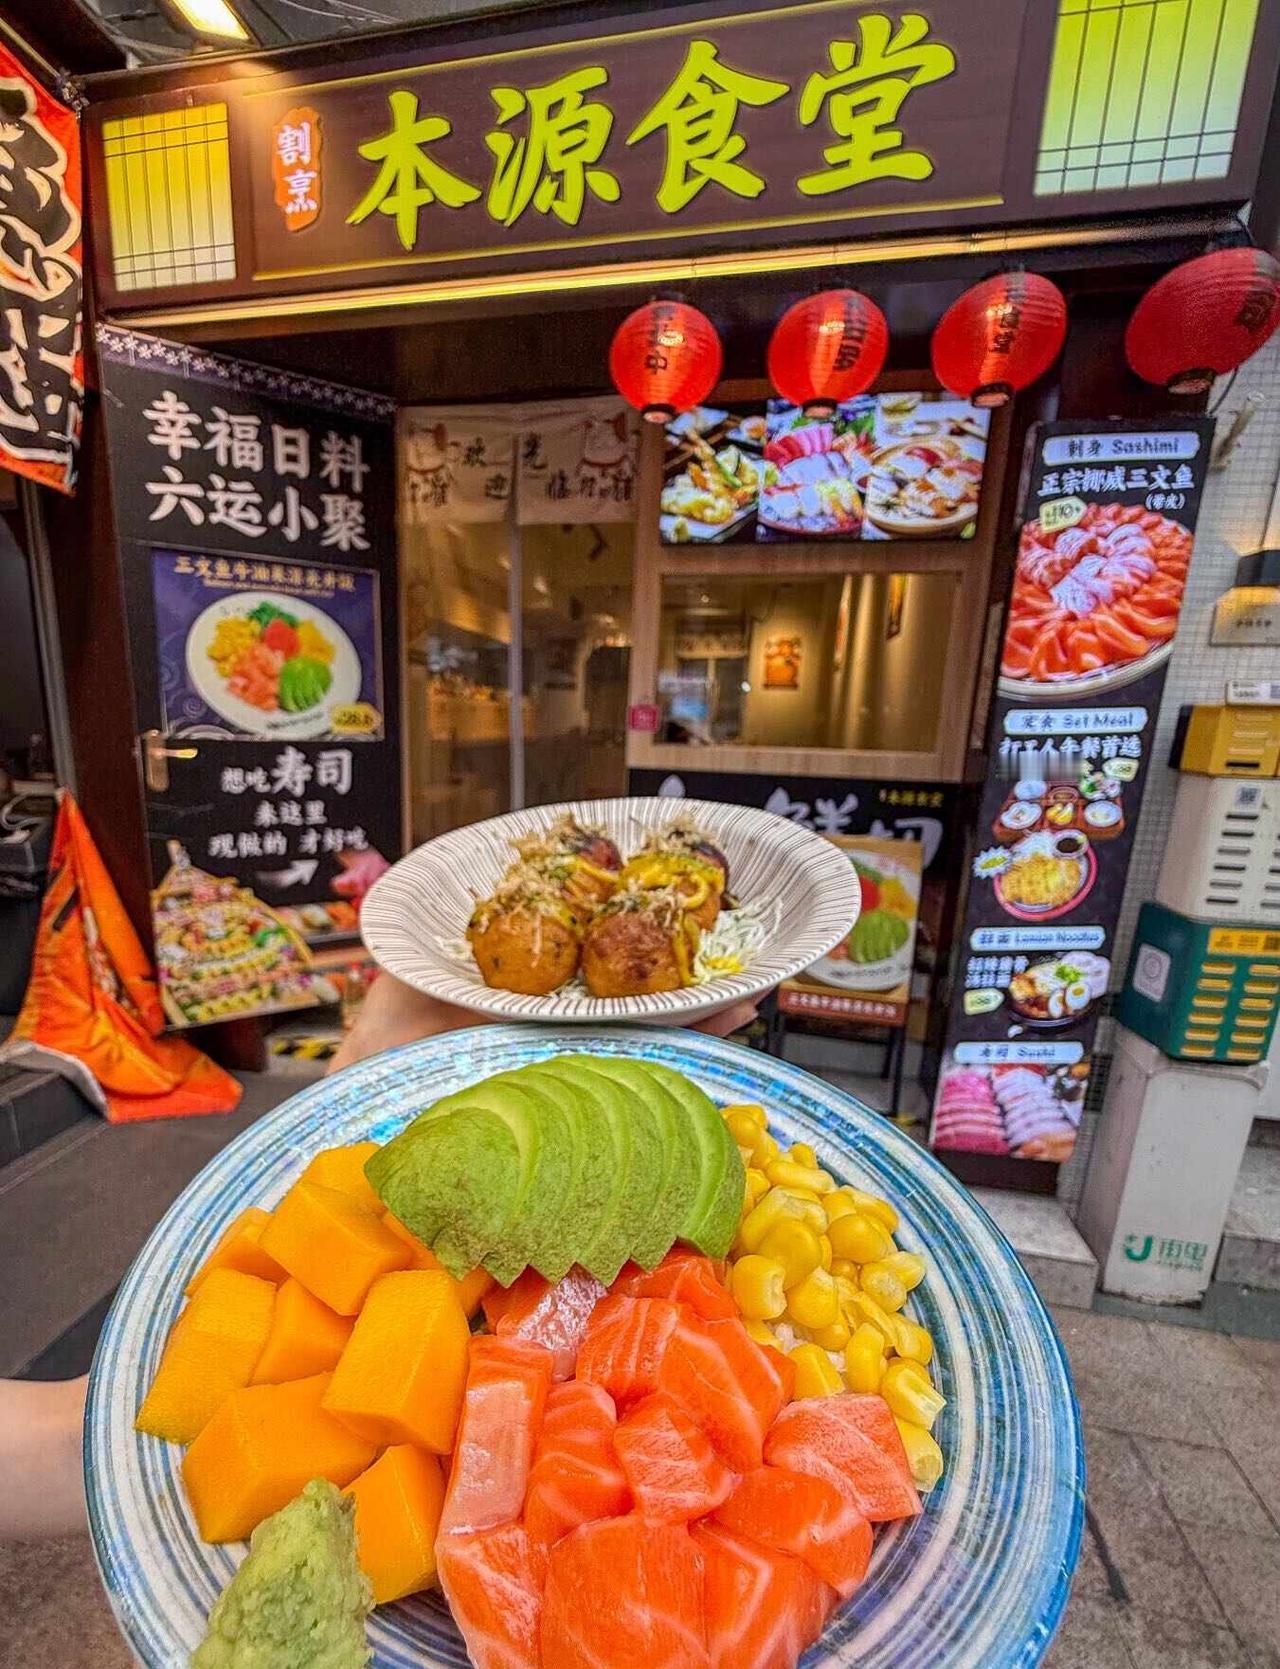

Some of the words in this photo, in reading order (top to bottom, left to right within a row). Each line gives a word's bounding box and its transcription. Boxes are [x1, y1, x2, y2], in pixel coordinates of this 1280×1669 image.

[345, 14, 956, 252] 本源食堂
[142, 390, 371, 493] 幸福日料
[1112, 437, 1179, 455] Sashimi
[145, 465, 372, 551] 六运小聚
[1037, 464, 1195, 497] 正宗挪威三文鱼
[220, 745, 353, 797] 想吃寿司
